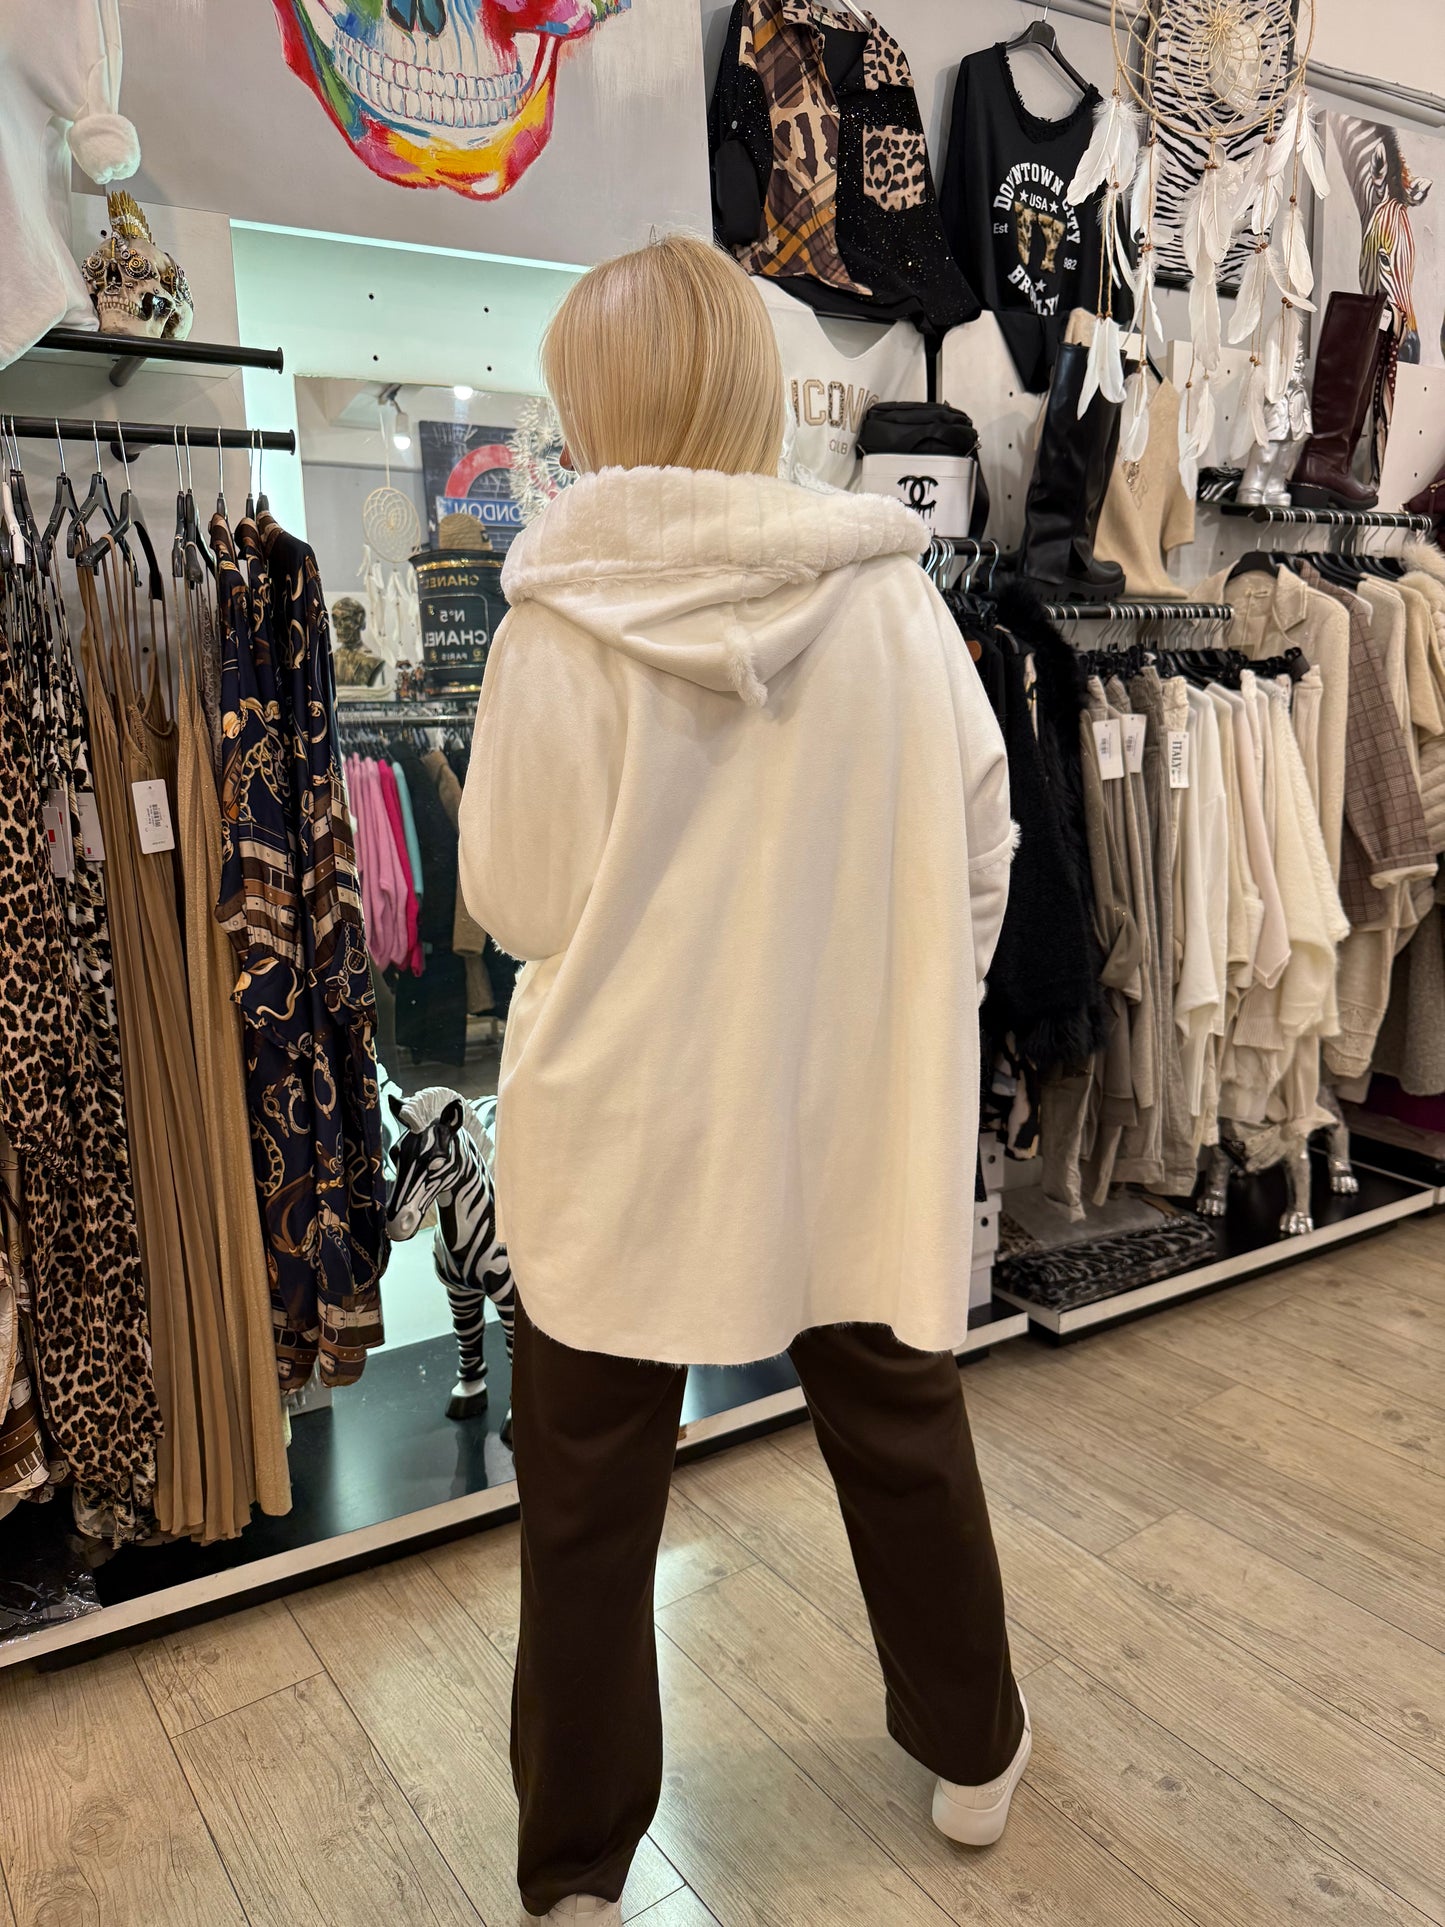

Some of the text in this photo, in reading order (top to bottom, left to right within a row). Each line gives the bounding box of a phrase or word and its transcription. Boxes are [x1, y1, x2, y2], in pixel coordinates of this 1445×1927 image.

[1029, 193, 1048, 211] USA
[993, 223, 1008, 234] Est
[791, 379, 879, 433] ICON
